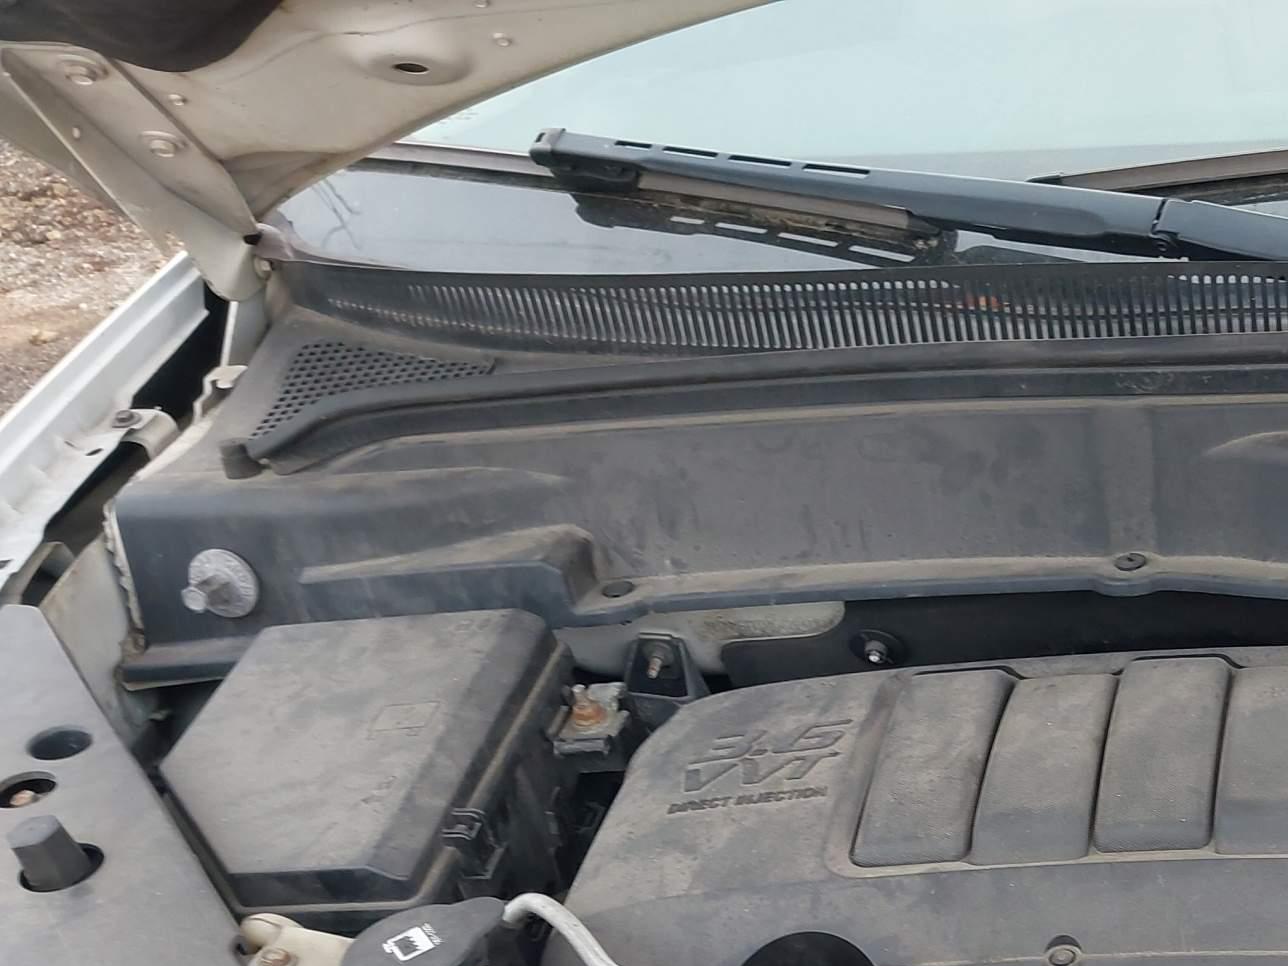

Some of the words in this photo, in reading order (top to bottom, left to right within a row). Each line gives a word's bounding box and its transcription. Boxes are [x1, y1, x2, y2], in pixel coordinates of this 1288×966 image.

[687, 719, 854, 765] 3.6
[684, 751, 841, 793] VVT
[667, 796, 733, 814] DIRECT
[734, 786, 829, 806] INJECTION
